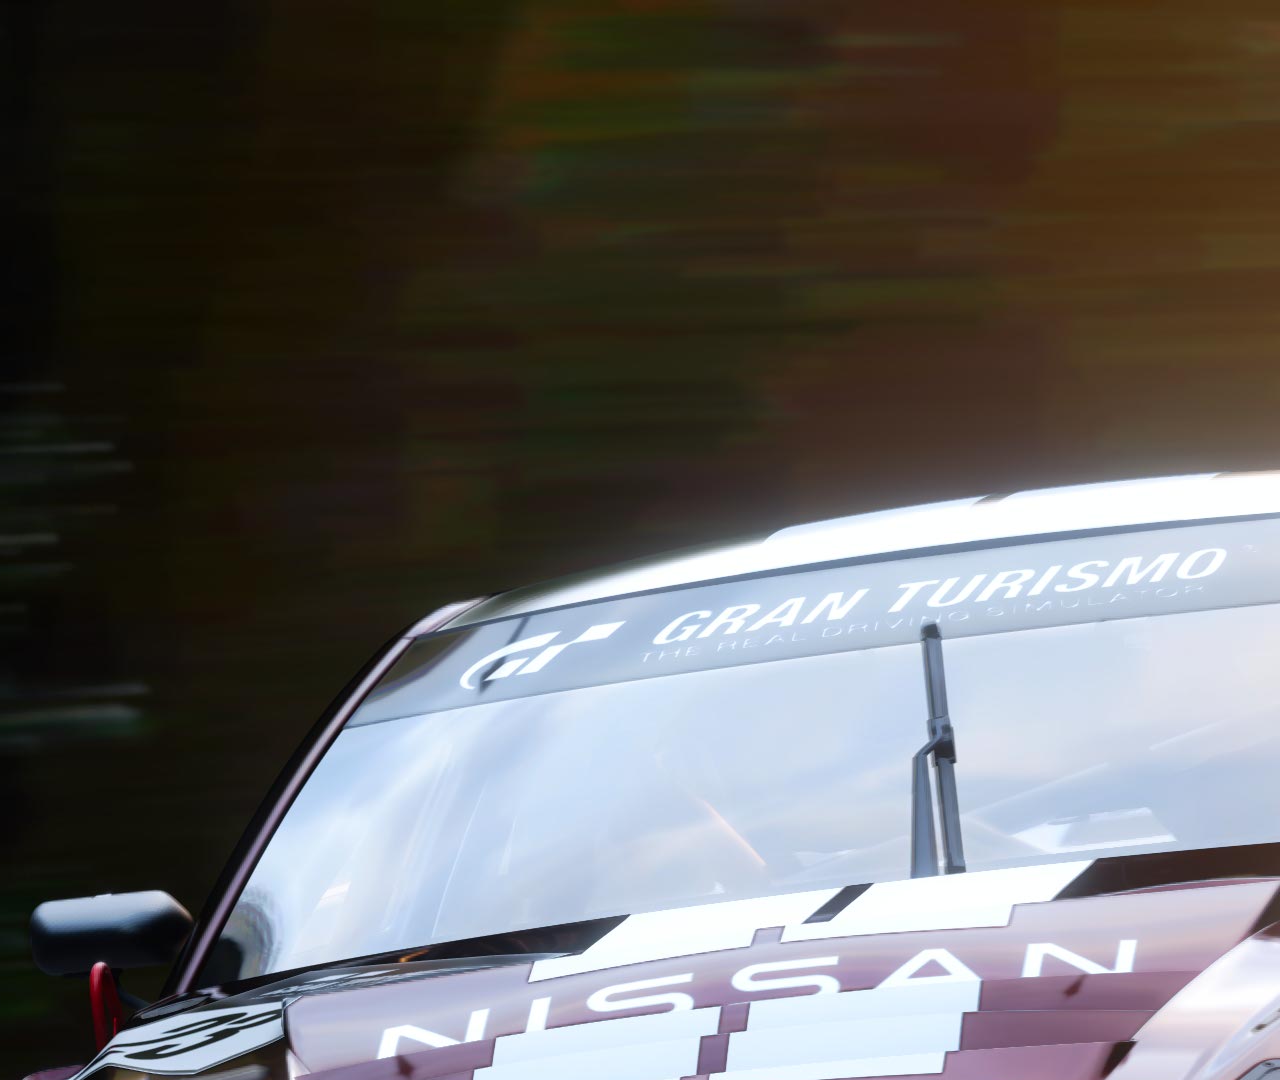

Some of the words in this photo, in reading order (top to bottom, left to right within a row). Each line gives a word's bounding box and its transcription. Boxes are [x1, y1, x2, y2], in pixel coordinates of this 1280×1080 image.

[652, 588, 870, 645] GRAN
[887, 547, 1228, 613] TURISMO
[641, 644, 698, 664] THE
[716, 632, 807, 653] REAL
[376, 939, 1138, 1060] NISSAN
